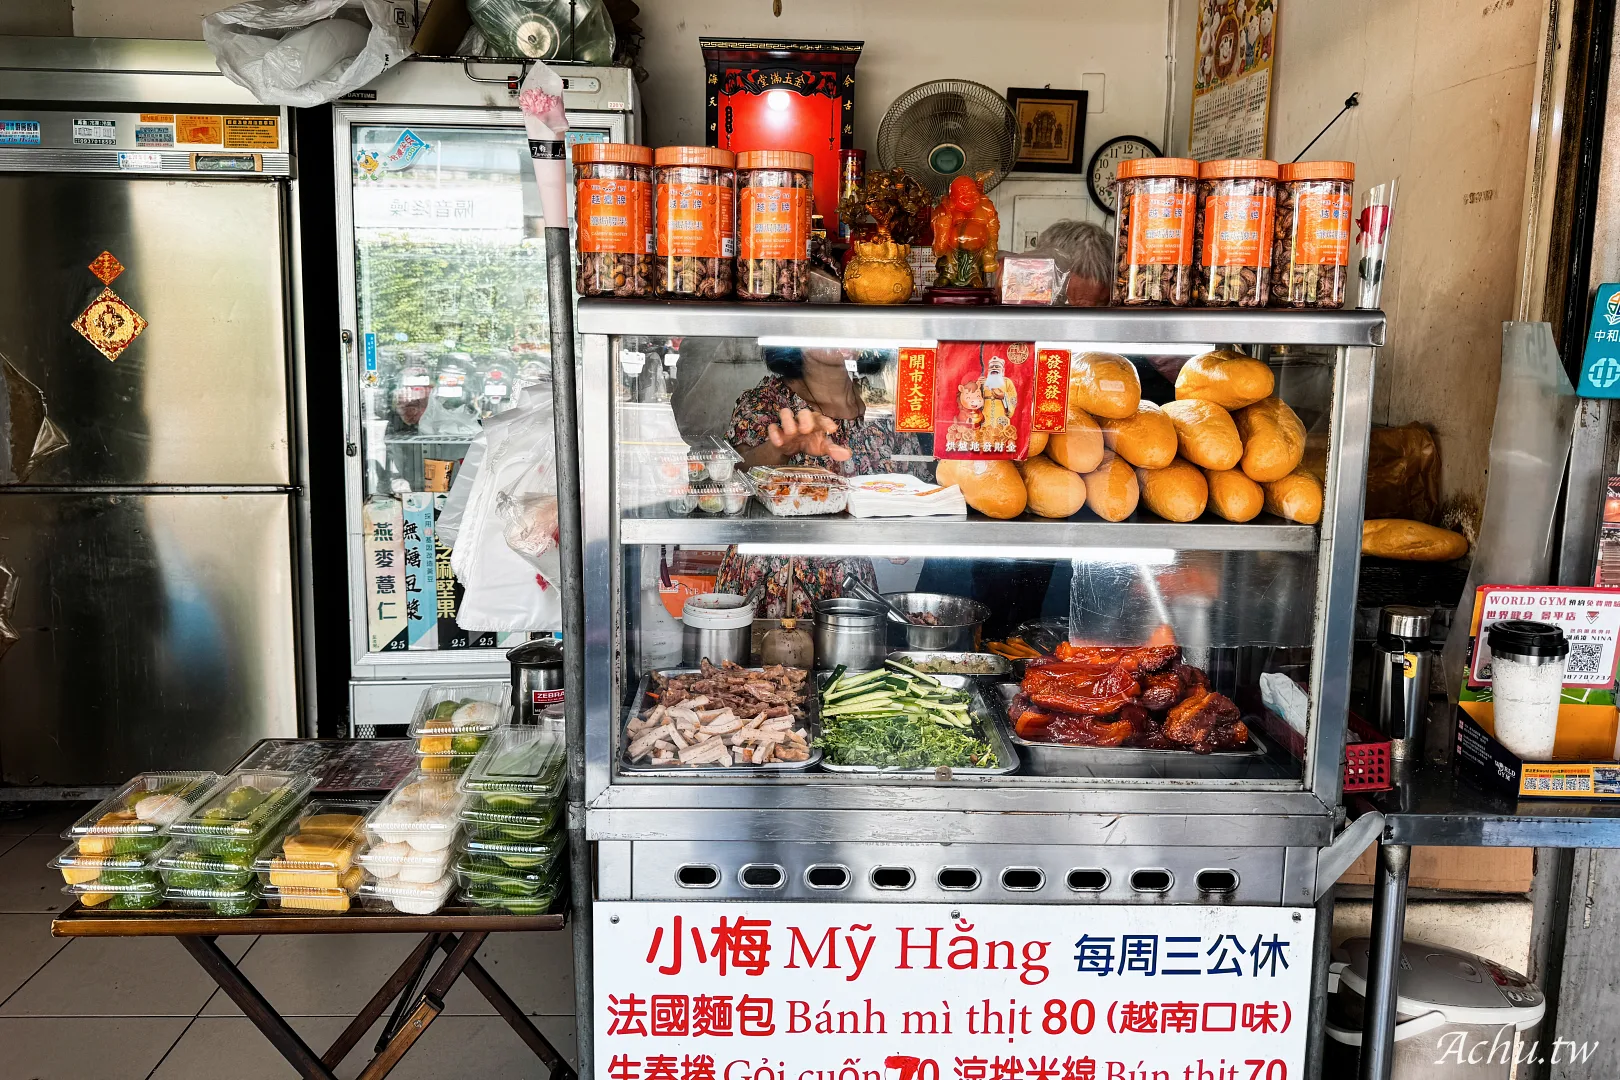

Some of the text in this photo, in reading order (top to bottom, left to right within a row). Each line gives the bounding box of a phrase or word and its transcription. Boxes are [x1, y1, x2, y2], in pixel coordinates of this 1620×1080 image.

[708, 73, 719, 148] 海天日
[1110, 148, 1118, 158] 11
[1123, 144, 1133, 154] 12
[1141, 149, 1145, 158] 1
[1099, 159, 1109, 168] 10
[1094, 173, 1101, 182] 9
[1098, 186, 1105, 196] 8
[1109, 197, 1115, 206] 7
[1594, 330, 1620, 343] 中和
[1044, 354, 1064, 400] 發發發
[908, 354, 926, 411] 開市大吉
[945, 441, 1018, 453] 烘爐地發財金
[373, 522, 397, 620] 燕麥薏仁
[1490, 596, 1535, 606] WORLD
[1539, 596, 1567, 606] GYM
[1486, 610, 1533, 620] 世界健身
[390, 640, 405, 650] 25
[451, 638, 466, 647] 25
[479, 637, 494, 646] 25
[537, 691, 564, 699] ZEBRA
[646, 914, 1290, 985] 小梅 Mỹ Hằng 每周三公休
[607, 993, 1291, 1043] 法國麵包 Bánh mì thịt 80 (越南口味)
[1245, 1059, 1287, 1080] 70
